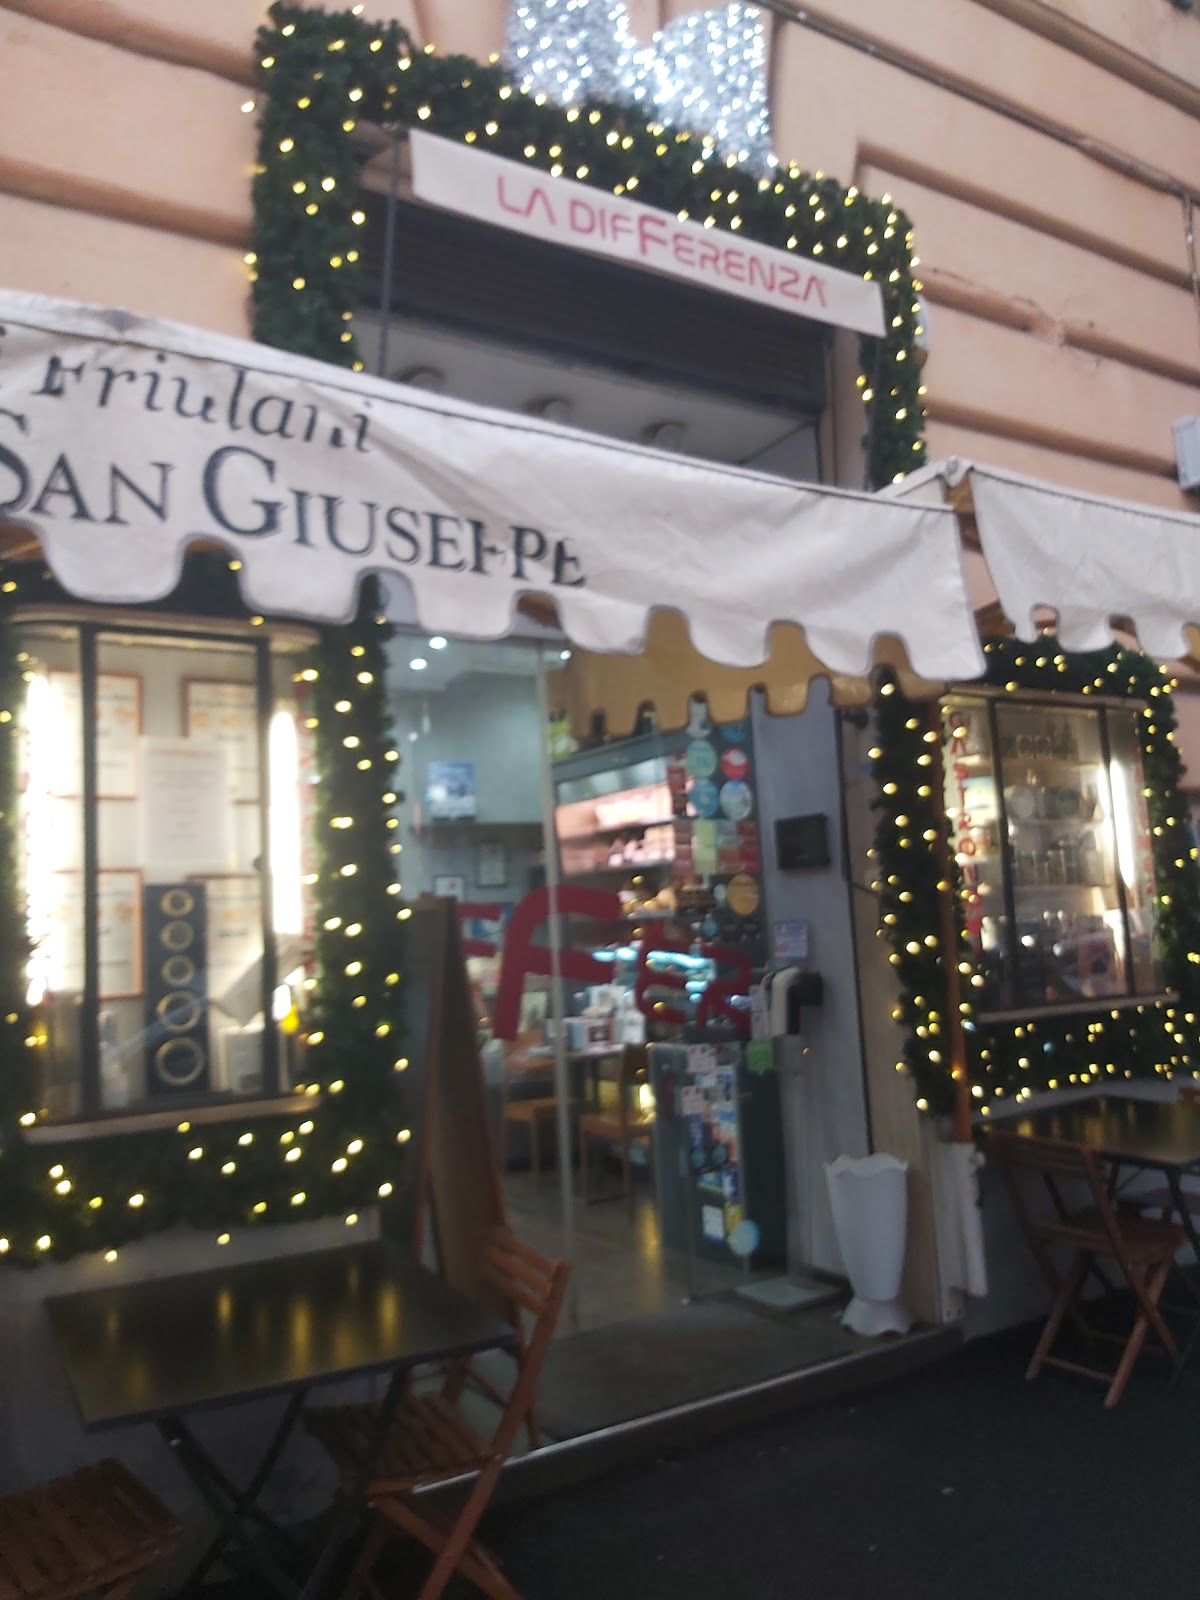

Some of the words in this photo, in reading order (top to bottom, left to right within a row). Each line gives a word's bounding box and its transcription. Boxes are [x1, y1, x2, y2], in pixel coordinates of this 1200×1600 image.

[496, 176, 556, 226] LA
[569, 199, 828, 309] DIFFERENZA
[31, 352, 374, 454] Friulani
